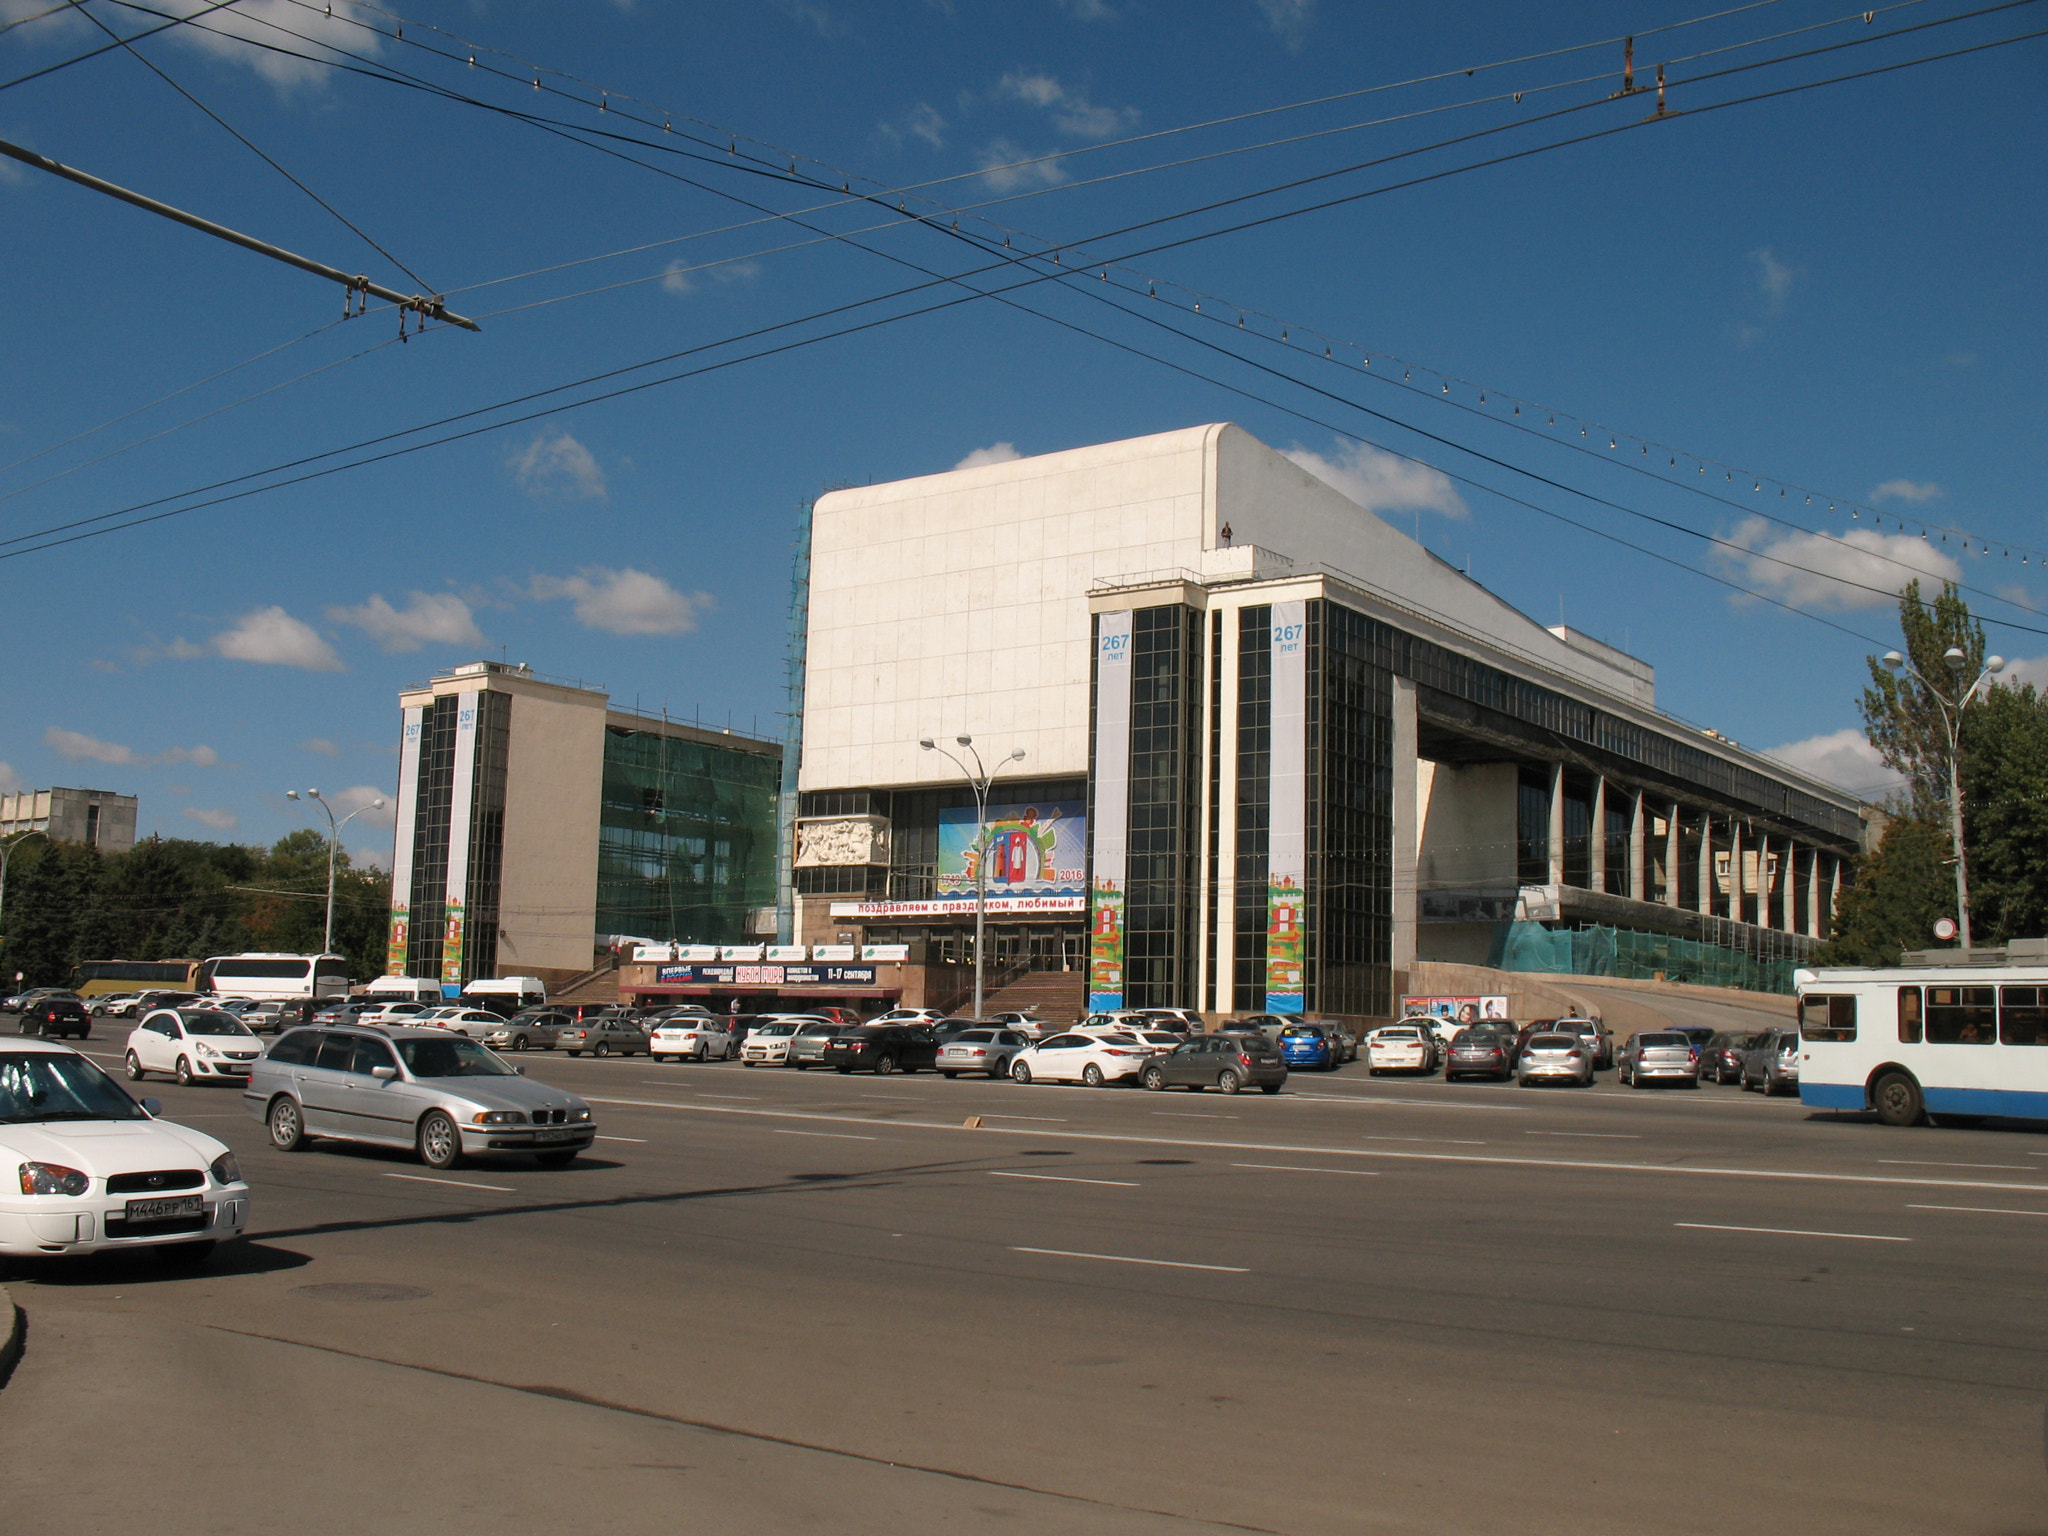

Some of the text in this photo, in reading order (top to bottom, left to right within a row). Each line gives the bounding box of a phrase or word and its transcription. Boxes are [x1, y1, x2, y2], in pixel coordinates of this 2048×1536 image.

[1274, 624, 1303, 642] 267
[1102, 634, 1130, 651] 267
[1281, 643, 1299, 652] лет
[1107, 652, 1125, 661] лет
[459, 709, 475, 722] 267
[405, 724, 421, 736] 267
[1060, 869, 1084, 881] 2016
[858, 902, 929, 915] поздравляем
[932, 903, 938, 911] с
[1017, 897, 1075, 909] любимый
[736, 966, 760, 983] КУБОК
[761, 966, 784, 983] МИРА
[827, 967, 843, 980] 11-17
[843, 969, 873, 982] сентября
[129, 1200, 179, 1217] М446РР
